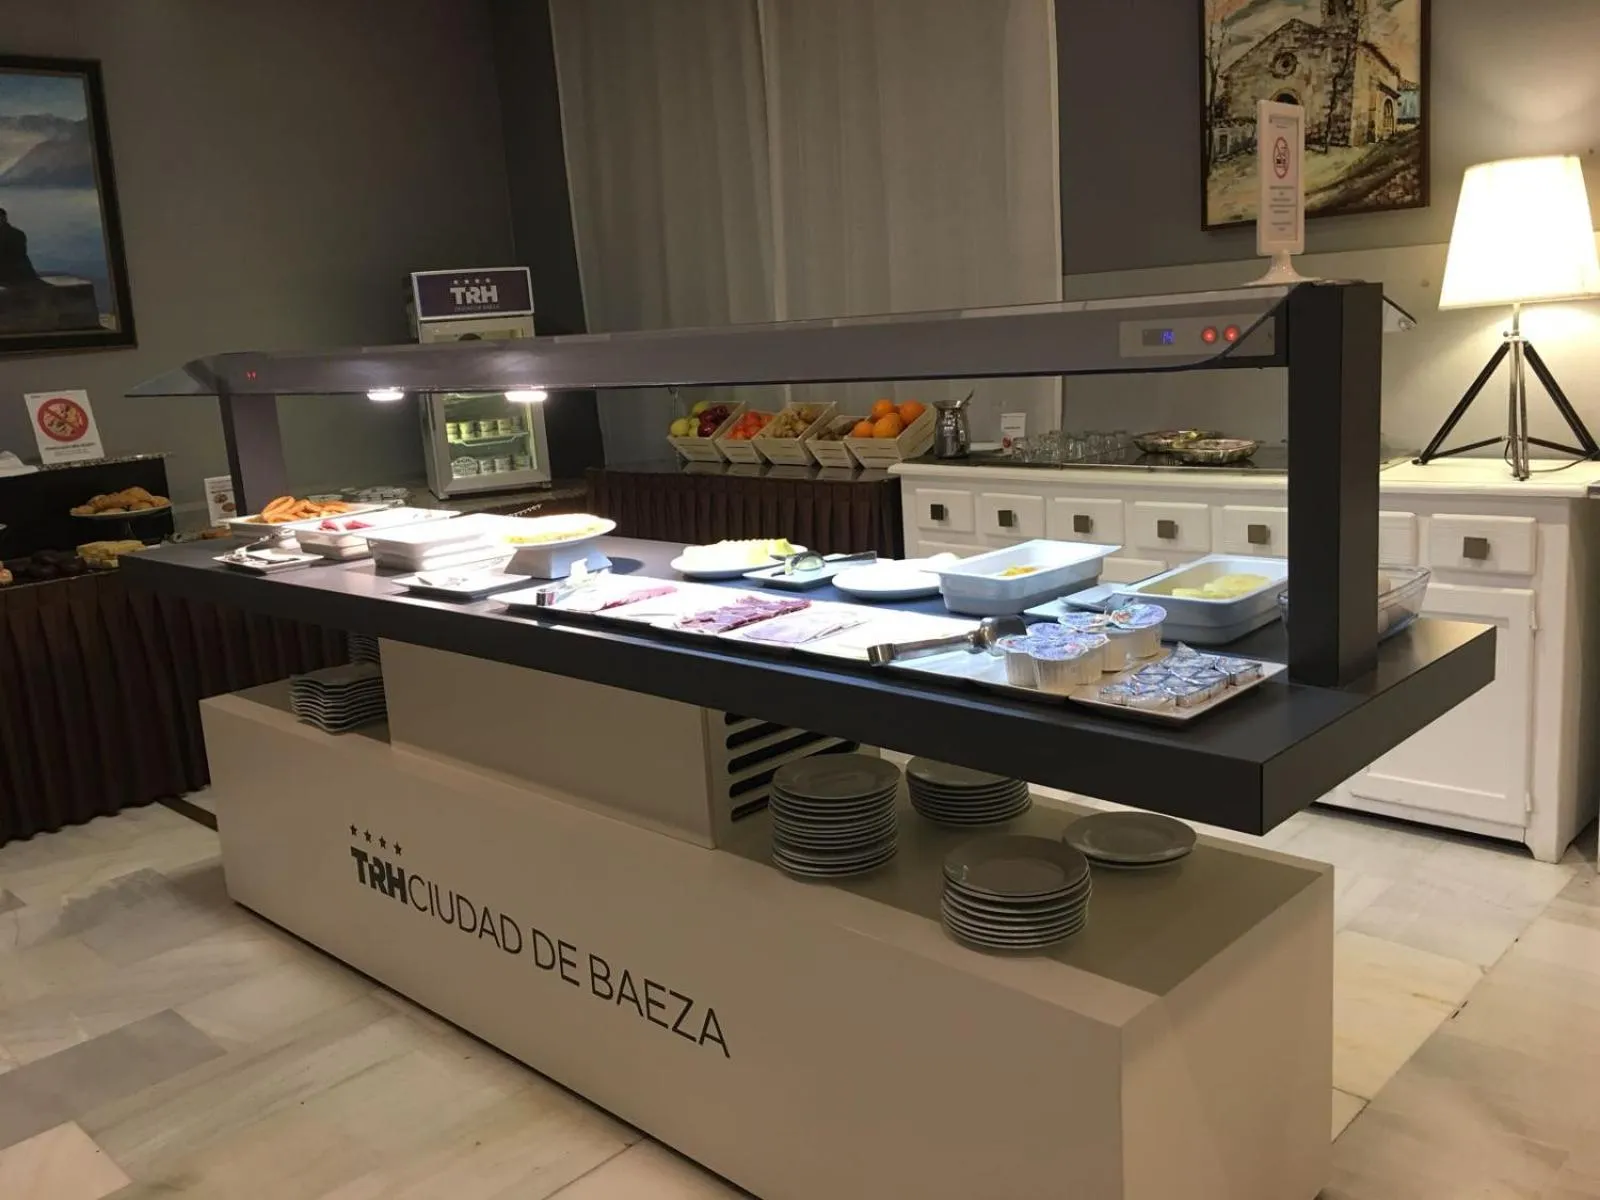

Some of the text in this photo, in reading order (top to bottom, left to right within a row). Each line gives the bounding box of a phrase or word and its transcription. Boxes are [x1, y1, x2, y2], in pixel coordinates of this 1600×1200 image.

[449, 285, 499, 305] TRH
[532, 927, 580, 987] DE
[589, 953, 731, 1059] BAEZA
